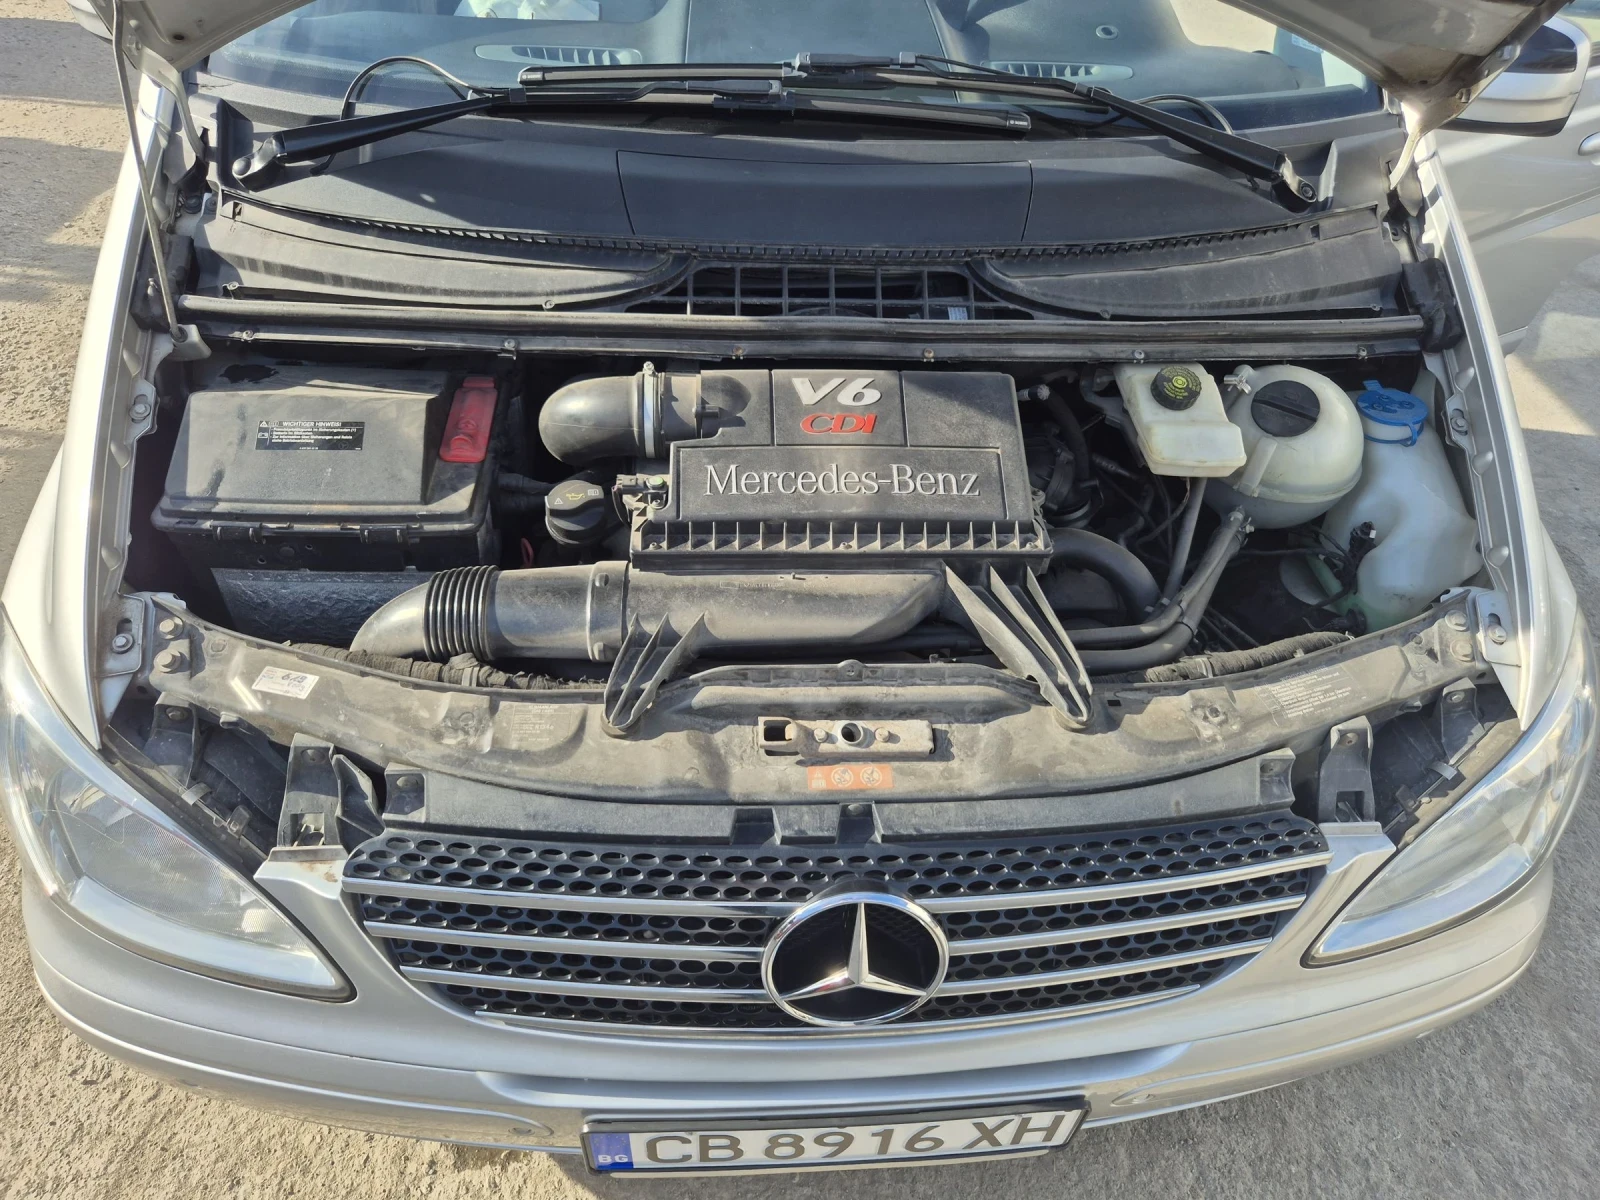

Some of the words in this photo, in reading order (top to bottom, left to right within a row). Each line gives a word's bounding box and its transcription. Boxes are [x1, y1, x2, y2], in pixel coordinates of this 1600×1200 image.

[791, 376, 883, 407] V6
[799, 412, 879, 435] CDI
[703, 463, 982, 497] Mercedes-Benz
[645, 1133, 744, 1164] CB
[763, 1124, 945, 1161] 8916
[961, 1114, 1067, 1150] XH
[597, 1154, 629, 1163] BG
